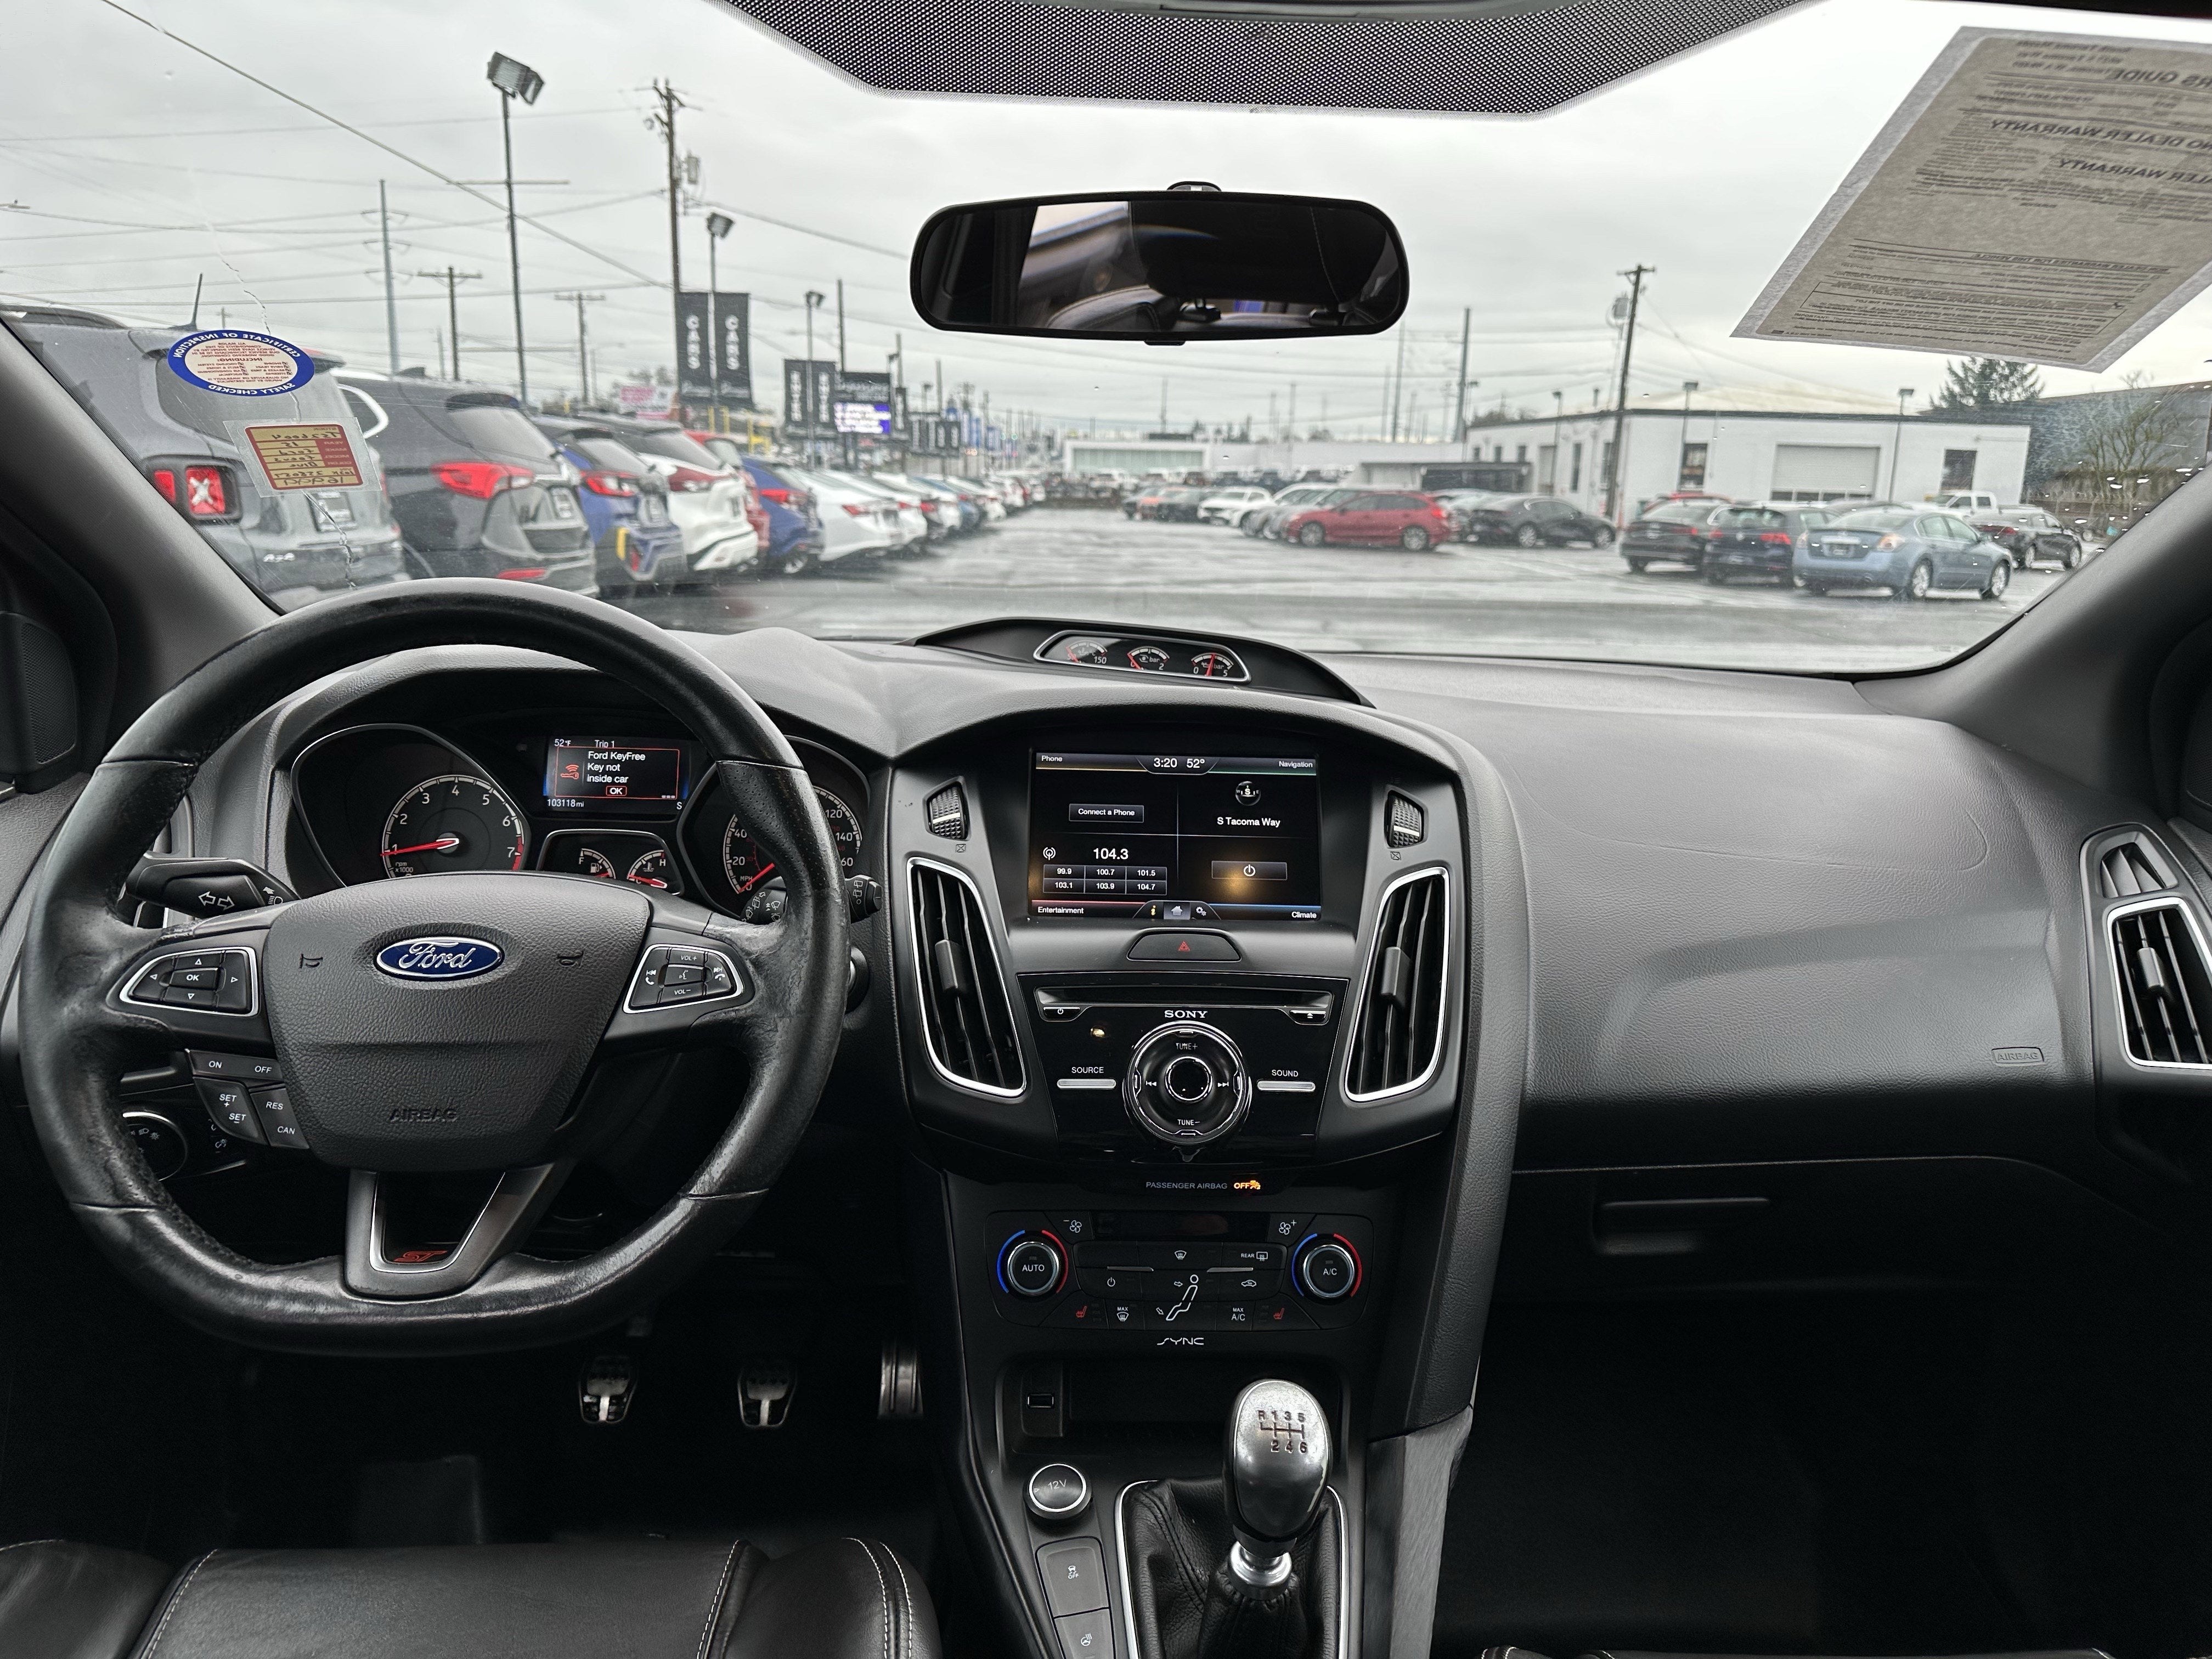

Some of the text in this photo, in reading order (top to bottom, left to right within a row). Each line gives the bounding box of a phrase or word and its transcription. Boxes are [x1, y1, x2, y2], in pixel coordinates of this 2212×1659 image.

[1193, 666, 1198, 674] 0
[588, 751, 646, 761] Ford KeyFree
[588, 763, 604, 772] Key
[1153, 758, 1205, 769] 3:20 52°
[452, 785, 459, 796] 4
[422, 793, 430, 804] 3
[482, 794, 490, 805] 5
[676, 802, 682, 810] S
[826, 809, 843, 819] 120
[400, 814, 408, 825] 2
[503, 816, 511, 827] 6
[1226, 817, 1260, 826] Tacoma
[1262, 818, 1280, 827] Way
[734, 829, 747, 838] 40
[836, 833, 853, 842] 140
[392, 844, 398, 854] 1
[507, 847, 515, 857] 7
[1093, 848, 1128, 860] 104.3
[732, 856, 745, 866] 20
[841, 857, 854, 866] 60
[398, 941, 476, 969] Ford
[1164, 1010, 1207, 1018] SONY
[1997, 1052, 2039, 1061] AIRBAG
[255, 1065, 272, 1074] OFF
[219, 1094, 237, 1102] SET
[266, 1102, 284, 1110] RES
[390, 1108, 458, 1123] AIRBAG
[277, 1126, 295, 1135] CAN
[1022, 1264, 1045, 1272] AUTO
[1323, 1268, 1337, 1276] A/C
[1157, 1337, 1204, 1345] SYNC
[1258, 1410, 1305, 1422] R 1 3 5
[1271, 1441, 1307, 1454] 2 4 6
[1048, 1479, 1067, 1490] 12V
